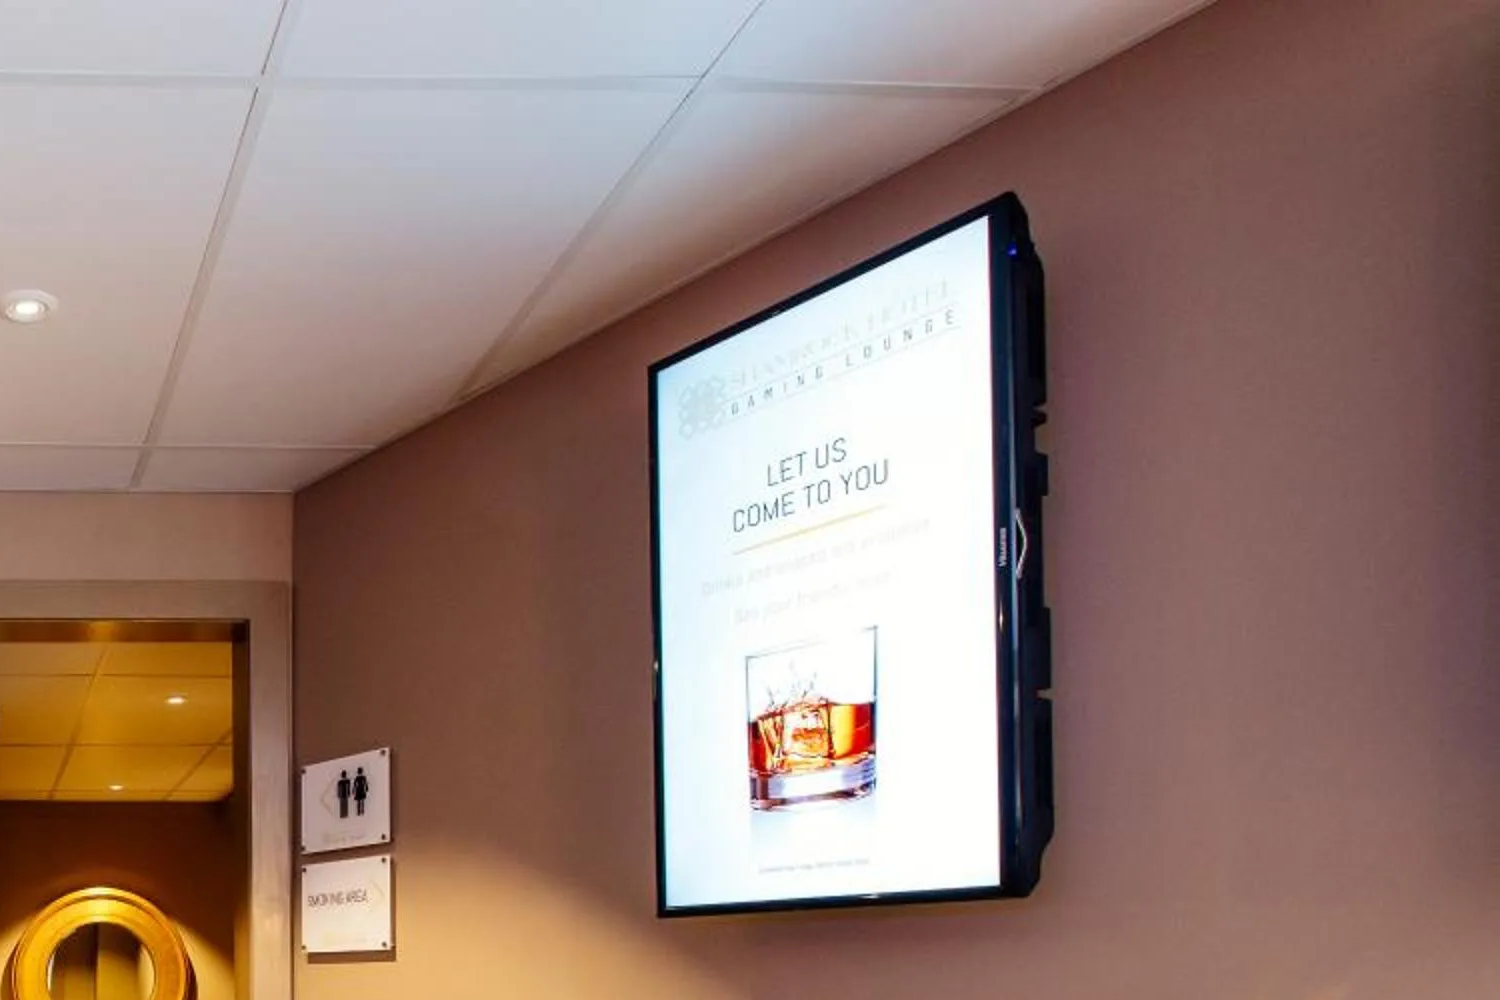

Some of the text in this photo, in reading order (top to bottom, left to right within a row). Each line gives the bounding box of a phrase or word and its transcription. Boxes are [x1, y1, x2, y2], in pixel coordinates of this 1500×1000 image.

[731, 365, 823, 415] GAMING
[845, 309, 955, 367] LOUNGE
[767, 437, 847, 487] LET US
[733, 458, 889, 533] COME TO YOU
[307, 888, 369, 907] SMOKING AREA
